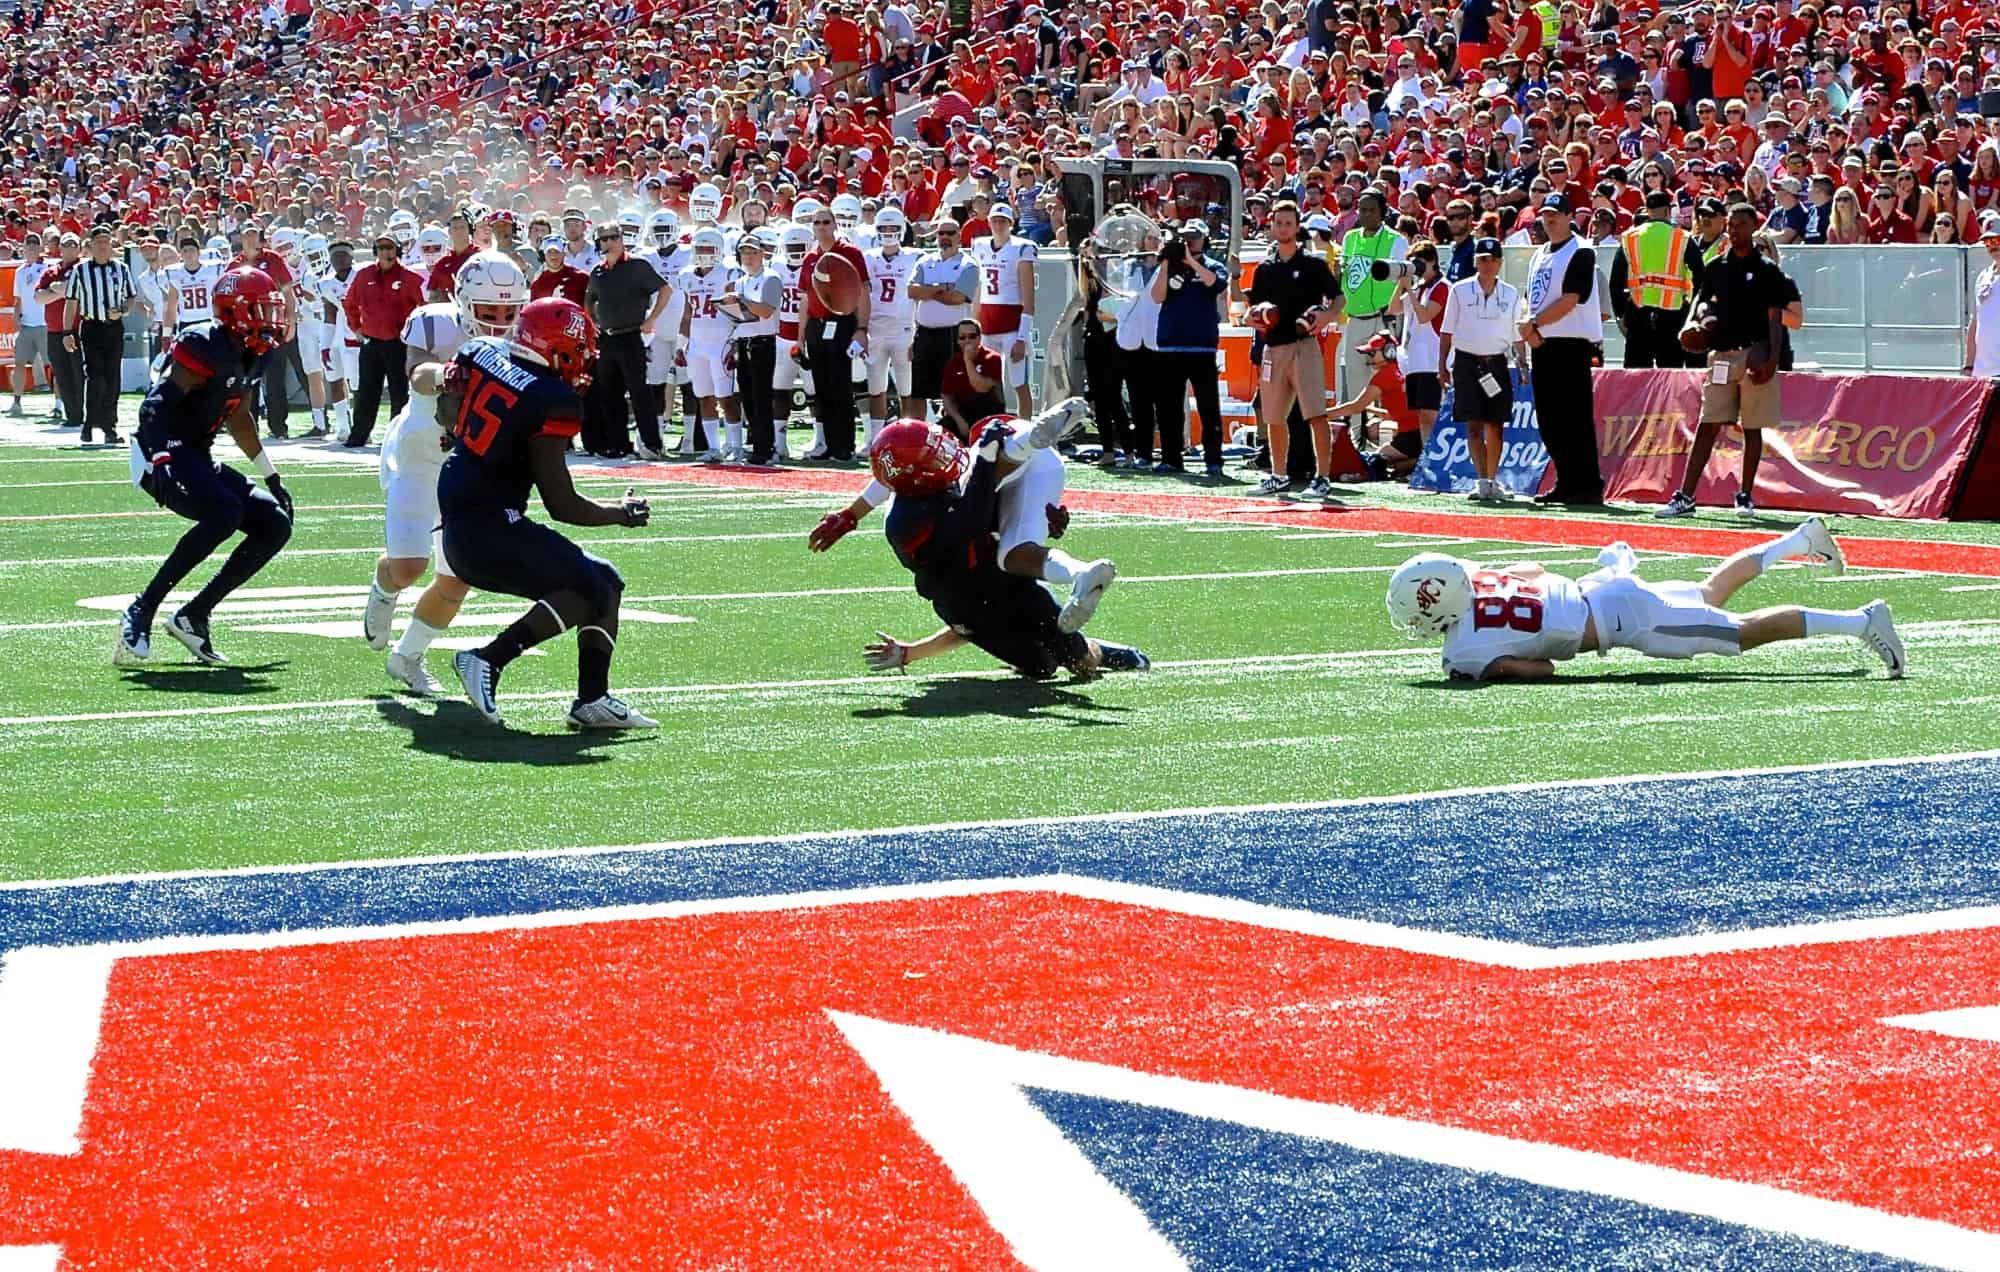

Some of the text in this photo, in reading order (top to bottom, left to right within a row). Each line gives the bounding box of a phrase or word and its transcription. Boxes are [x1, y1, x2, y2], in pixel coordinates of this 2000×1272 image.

[182, 287, 208, 309] 38
[879, 278, 897, 303] 6
[986, 268, 1000, 295] 3
[455, 368, 519, 457] 15
[1428, 427, 1551, 472] Spnsor
[1602, 412, 1745, 458] WELS
